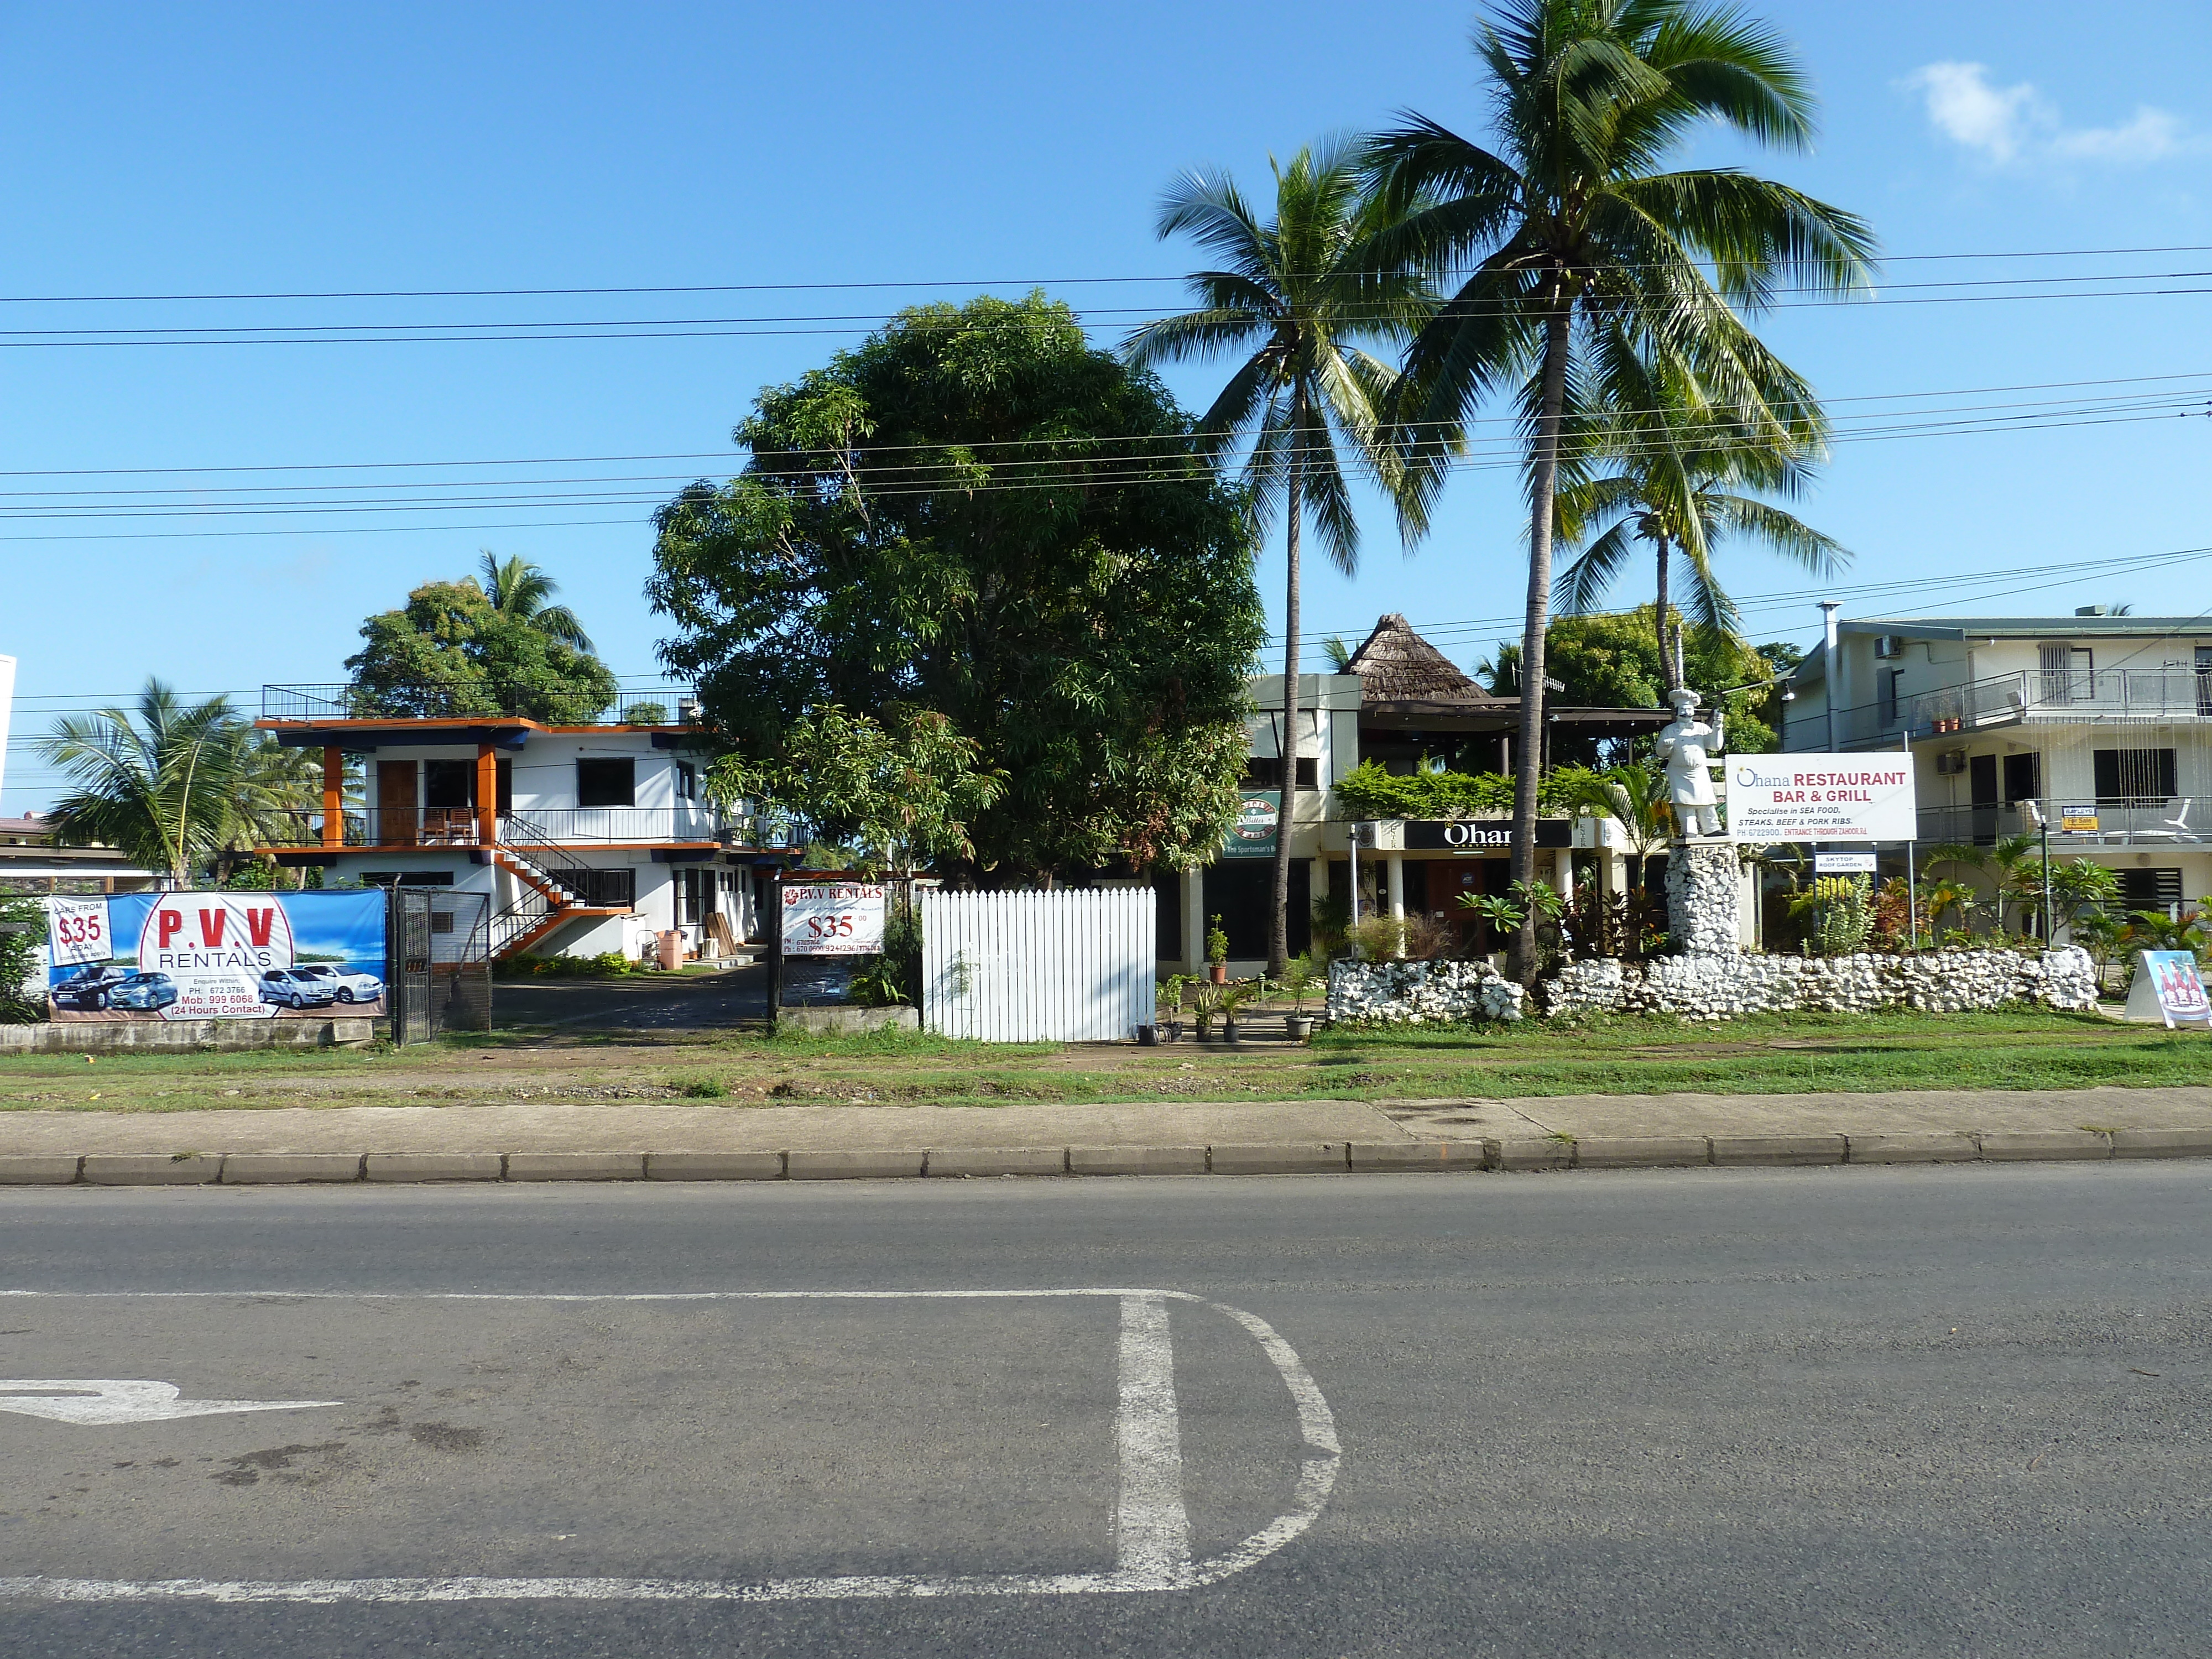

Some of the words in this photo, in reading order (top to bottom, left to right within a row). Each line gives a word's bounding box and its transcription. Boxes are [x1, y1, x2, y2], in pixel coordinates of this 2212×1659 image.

[1737, 768, 1790, 787] Ohana
[1794, 773, 1906, 786] RESTAURANT
[1773, 791, 1806, 802] BAR
[1811, 791, 1822, 802] &
[1826, 790, 1871, 802] GRILL
[1238, 845, 1270, 855] Sportsman's
[800, 888, 826, 899] P.V.V
[828, 888, 883, 899] RENTALS
[79, 903, 102, 911] FROM
[59, 915, 101, 947] $35
[808, 915, 853, 940] $35
[160, 952, 271, 968] RENTALS
[182, 996, 206, 1004] Mob:
[230, 995, 253, 1003] 6068
[171, 1006, 186, 1016] (24
[189, 1006, 218, 1015] Hours
[222, 1005, 265, 1015] Contact)
